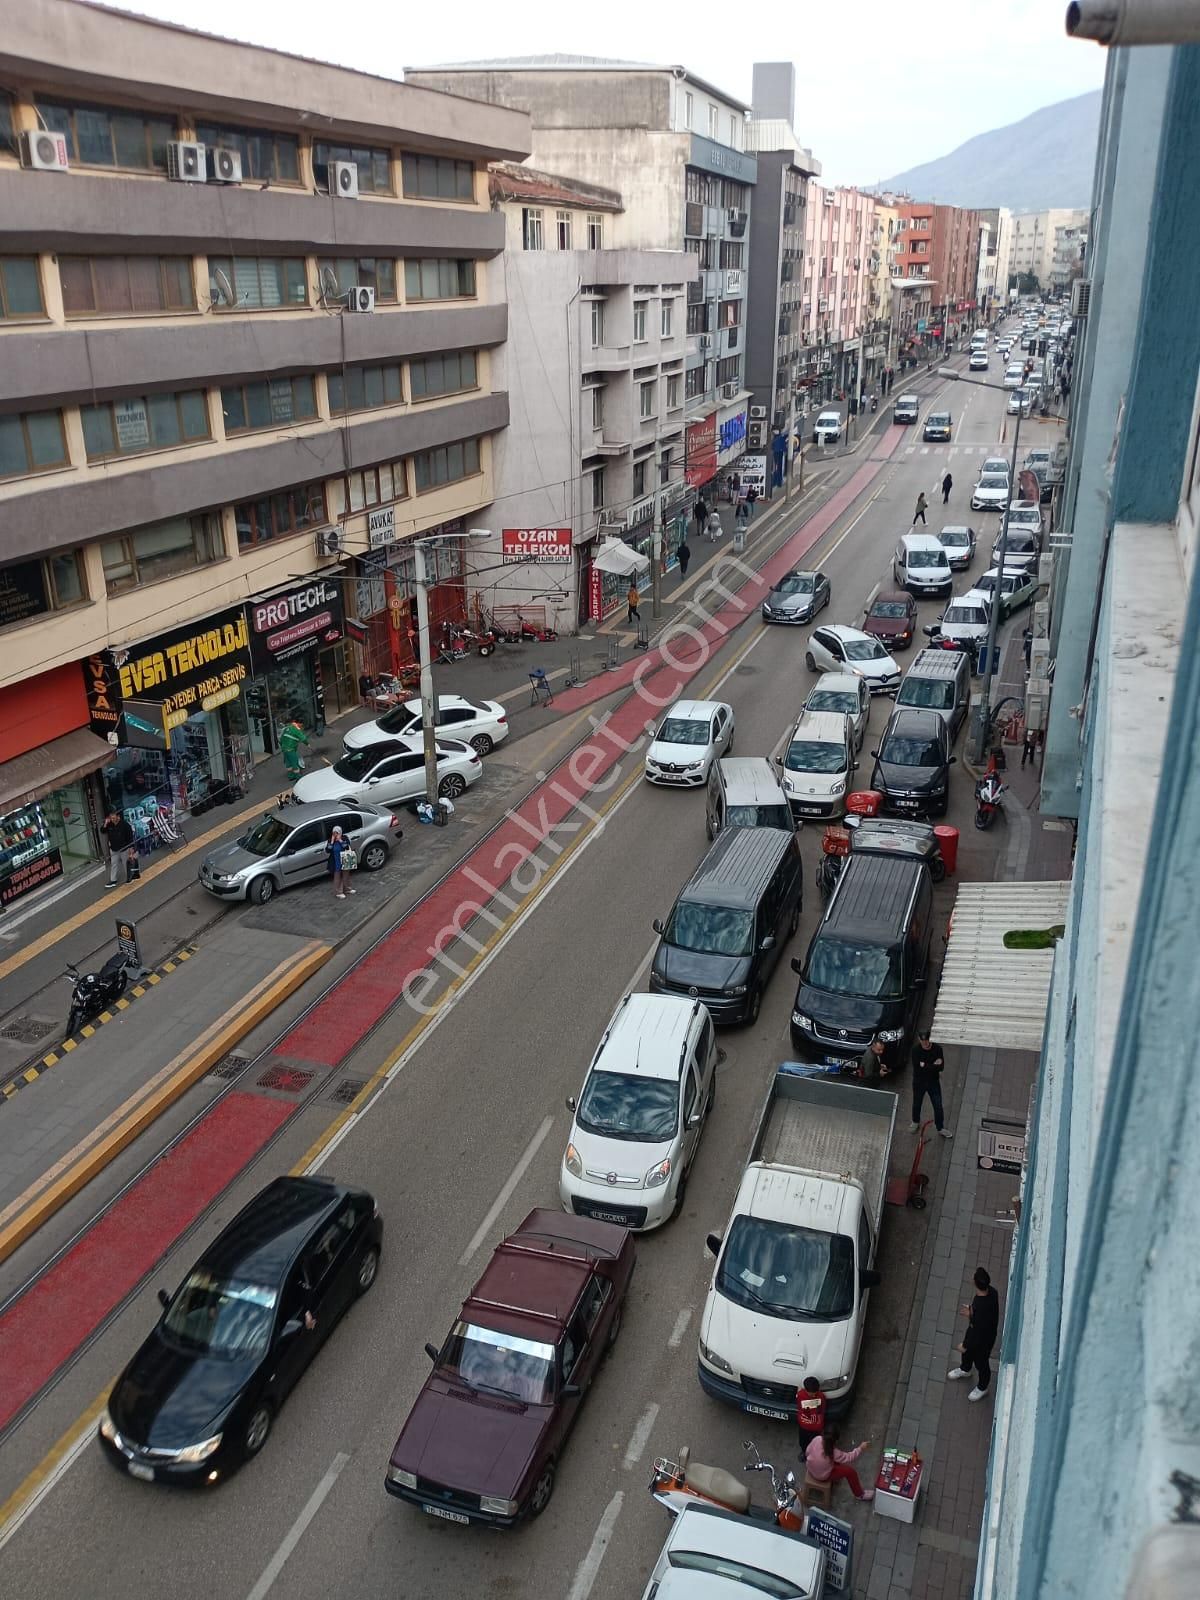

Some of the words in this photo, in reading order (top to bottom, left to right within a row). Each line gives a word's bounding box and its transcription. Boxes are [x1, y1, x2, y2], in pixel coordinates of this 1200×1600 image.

[370, 511, 394, 531] AVUKAT
[517, 530, 558, 542] OZAN
[504, 543, 571, 555] TELEKOM
[256, 582, 326, 631] PROTECH
[119, 652, 167, 698] EVSA
[165, 612, 248, 677] TEKNOLOJİ
[820, 1521, 841, 1536] YÜCEL
